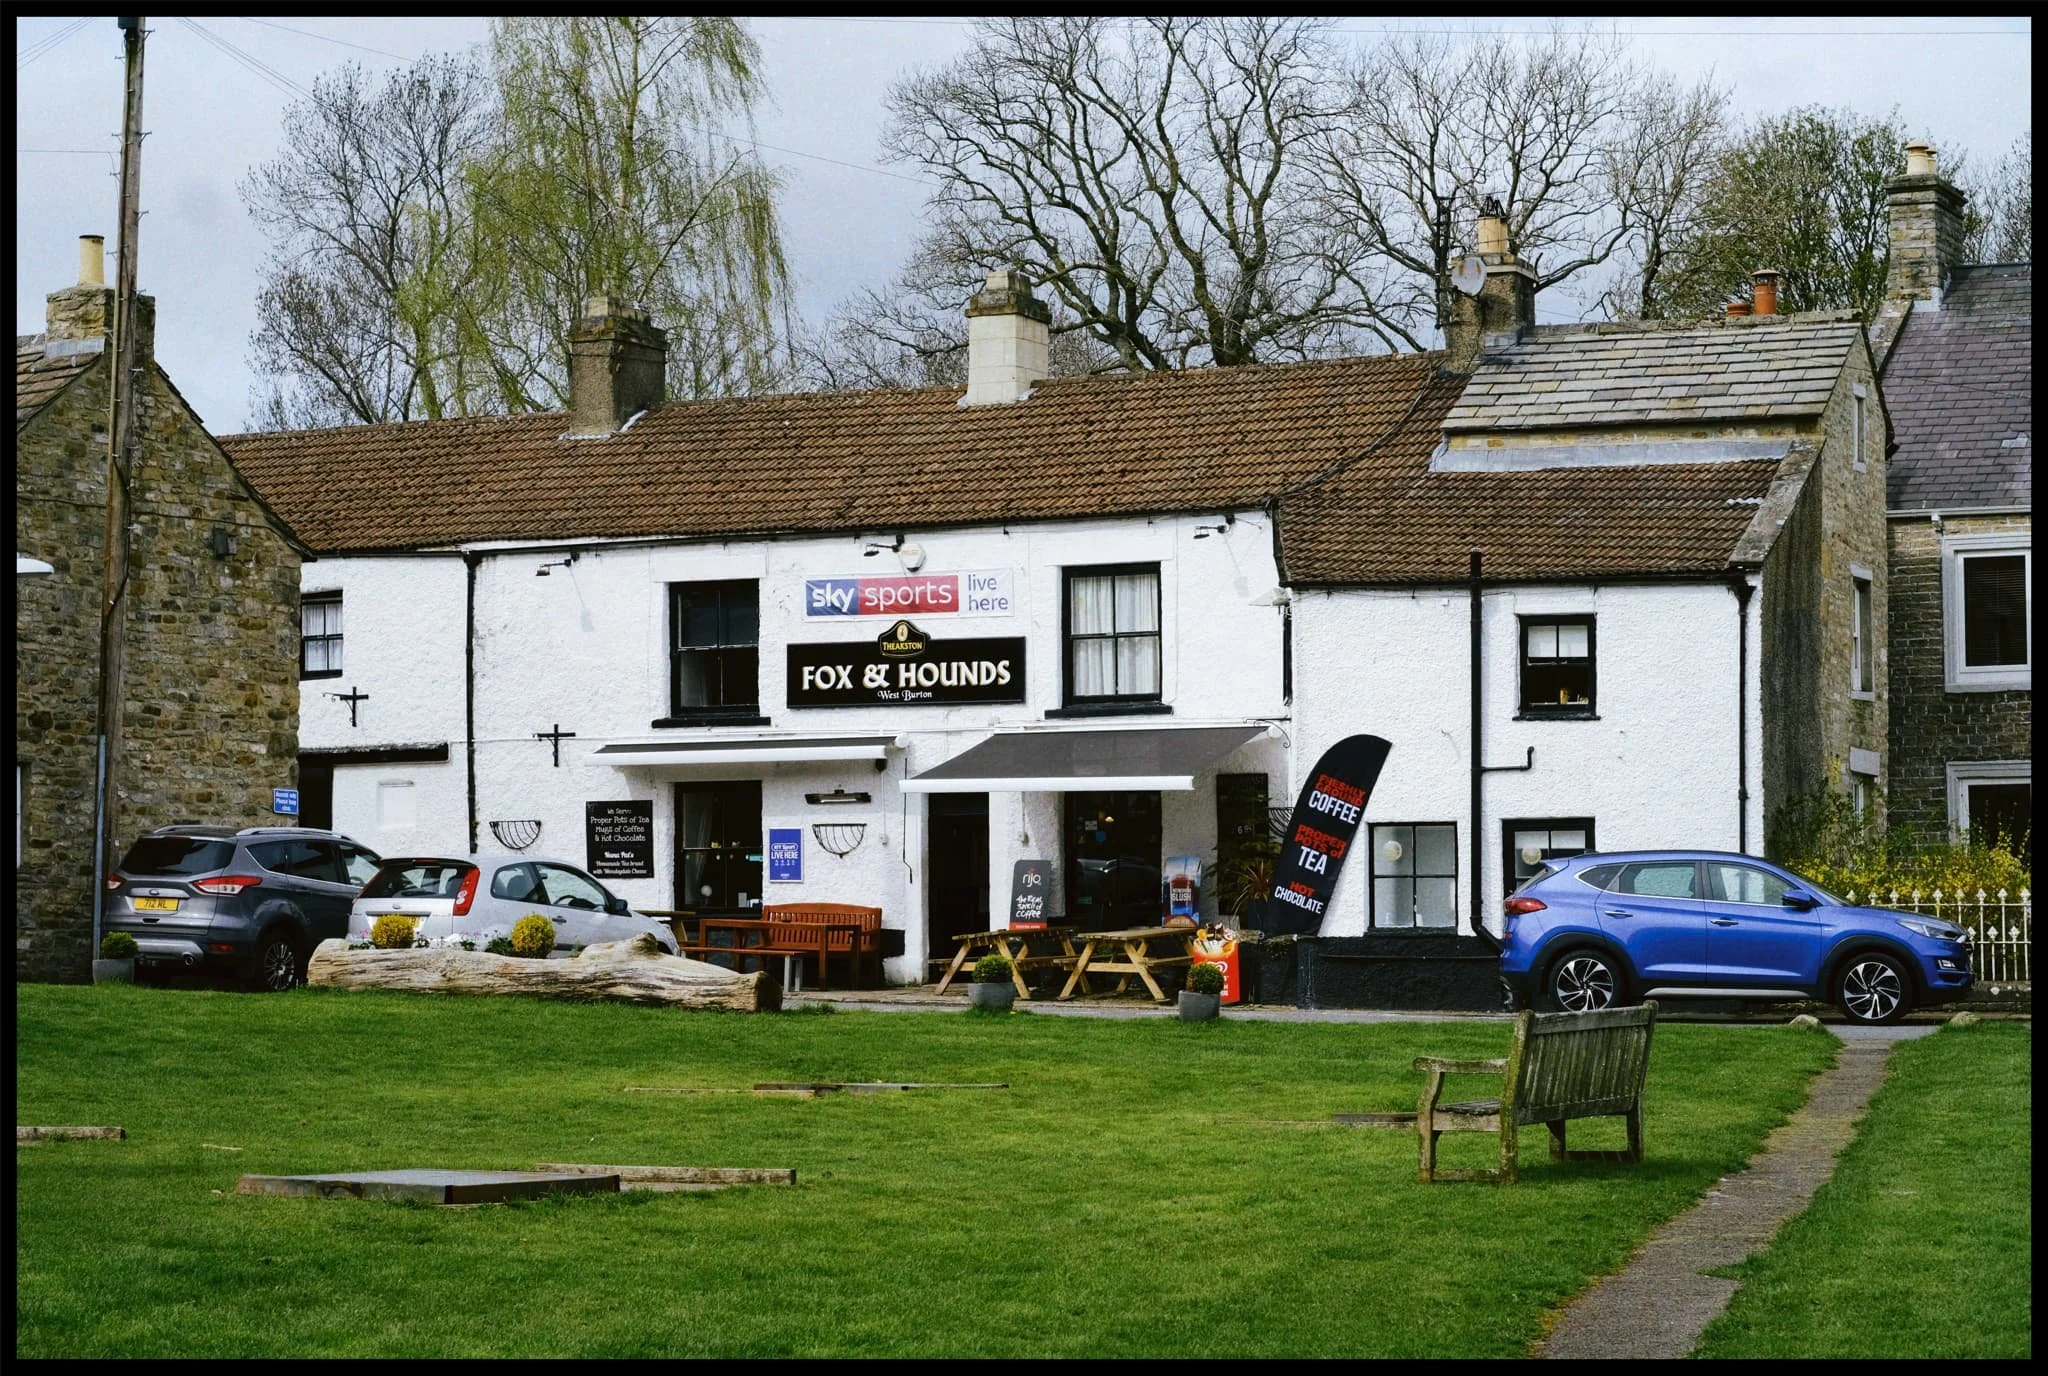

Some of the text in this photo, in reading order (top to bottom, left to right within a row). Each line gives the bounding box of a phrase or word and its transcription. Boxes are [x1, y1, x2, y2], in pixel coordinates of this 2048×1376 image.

[967, 574, 998, 592] live
[812, 581, 953, 613] sky sports
[968, 595, 1009, 612] here
[882, 641, 923, 651] THEAKSTON
[801, 660, 1012, 691] FOX & HOUNDS
[877, 689, 933, 702] West Burton
[1315, 782, 1363, 807] GROUND
[1308, 790, 1361, 824] COFFEE
[590, 816, 613, 825] Proper
[614, 816, 628, 824] Pots
[595, 826, 613, 834] Mugs
[622, 825, 645, 833] Coffee
[613, 834, 646, 842] Chocolate
[1295, 833, 1328, 852] POTS
[1297, 824, 1347, 849] PROPER
[771, 851, 799, 859] LIVE HERE
[1298, 845, 1328, 875] TEA
[1289, 881, 1316, 897] HOT
[1274, 885, 1324, 914] CHOCOLATE
